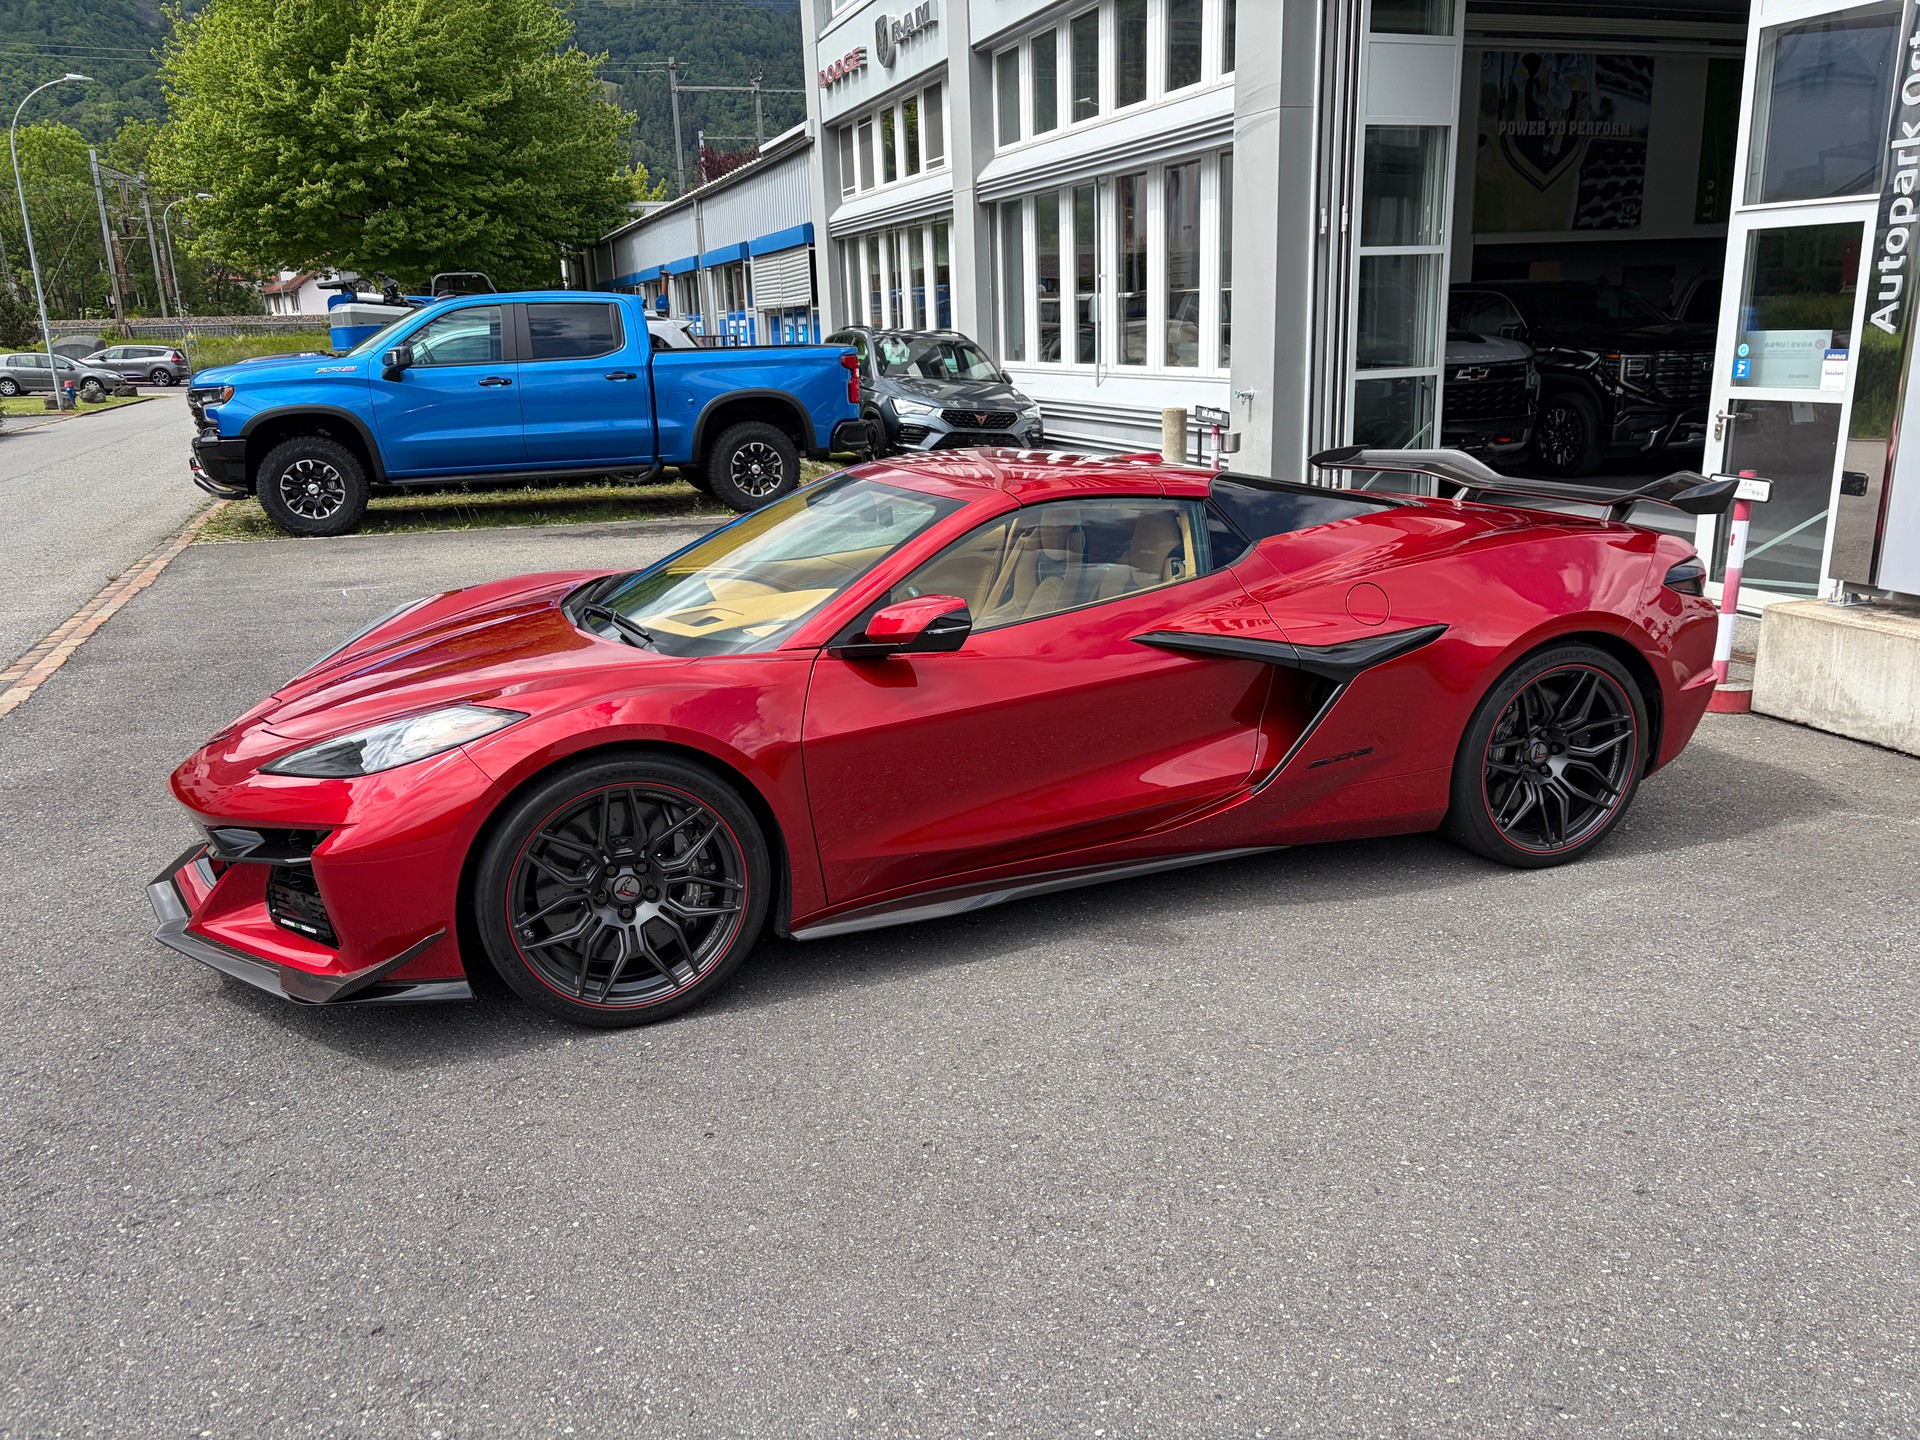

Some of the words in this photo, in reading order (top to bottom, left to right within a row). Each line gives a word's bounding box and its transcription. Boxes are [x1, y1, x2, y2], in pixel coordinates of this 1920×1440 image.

[891, 1, 932, 43] RAM
[818, 46, 864, 88] DODGE
[1498, 120, 1546, 136] POWER
[1547, 120, 1567, 136] TO
[1568, 120, 1631, 136] PERFORM
[1870, 121, 1920, 334] Autopark
[1201, 409, 1222, 420] RAM
